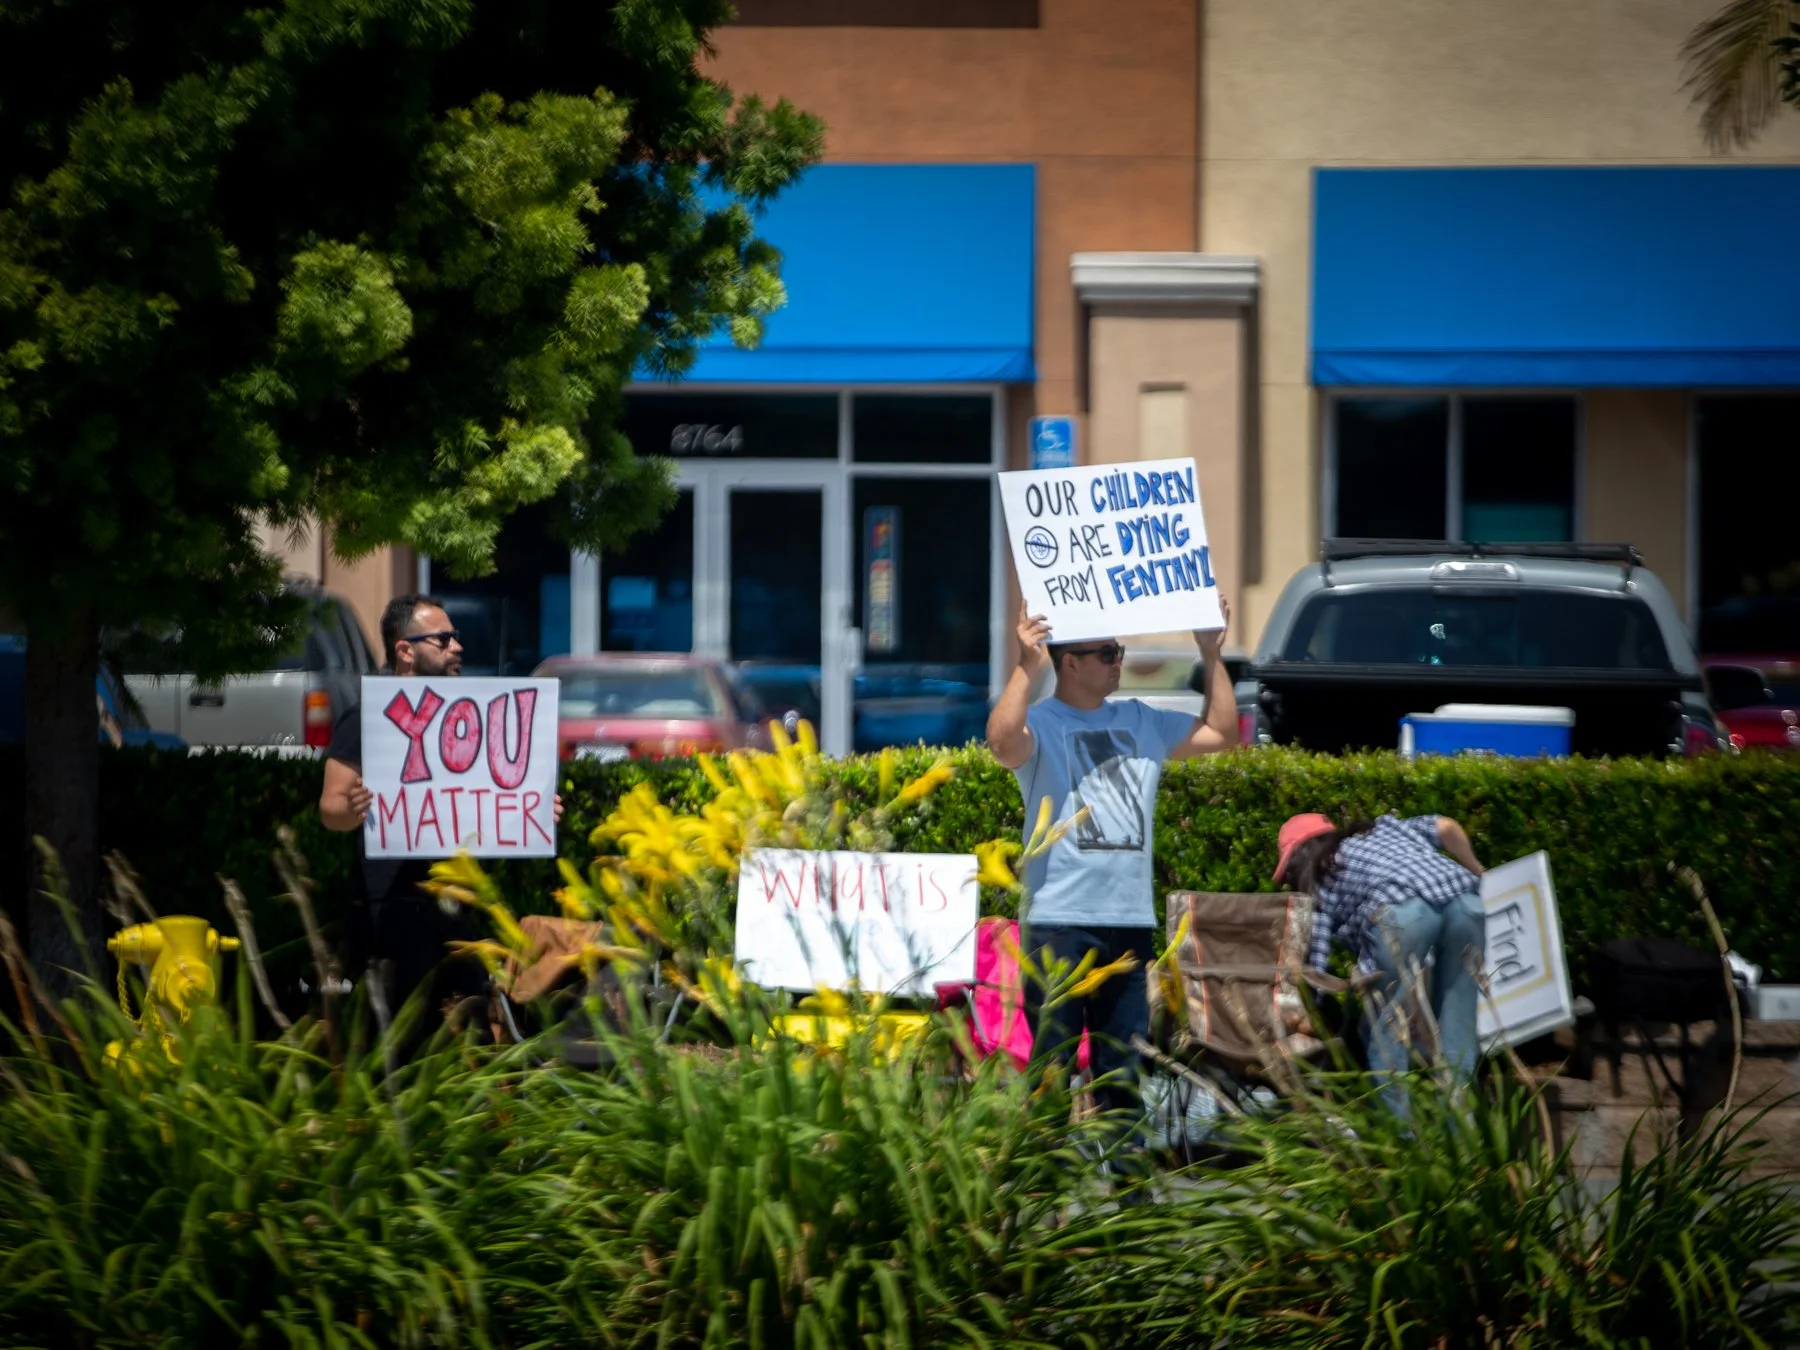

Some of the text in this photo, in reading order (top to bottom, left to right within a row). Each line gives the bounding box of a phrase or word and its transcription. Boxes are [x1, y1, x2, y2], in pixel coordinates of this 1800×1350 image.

[671, 423, 743, 452] 8764
[1025, 480, 1079, 517] OUR
[1069, 524, 1113, 563] ARE
[1043, 564, 1104, 610] FROM
[383, 685, 538, 790] YOU
[377, 786, 552, 852] MATTER
[1486, 902, 1536, 987] Find
